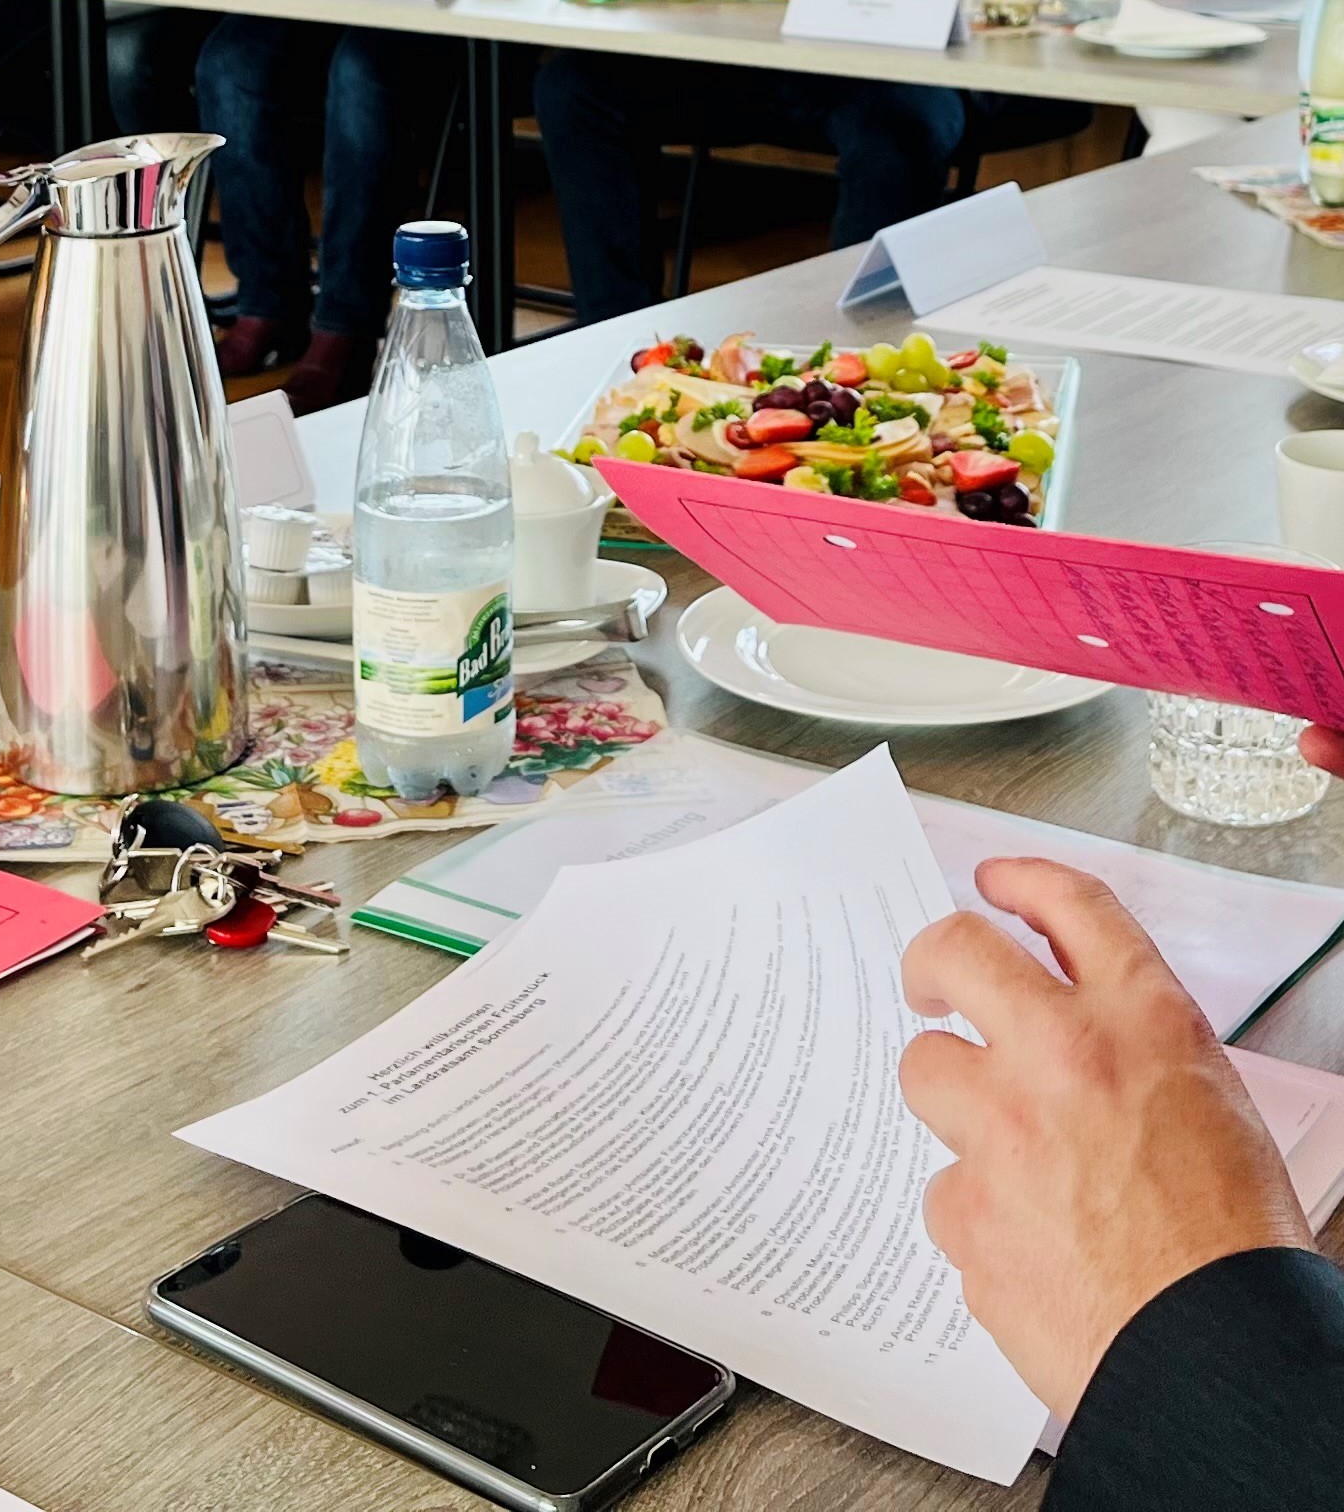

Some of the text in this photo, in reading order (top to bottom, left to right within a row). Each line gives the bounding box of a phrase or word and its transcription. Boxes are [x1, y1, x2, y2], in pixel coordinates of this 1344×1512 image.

[458, 642, 488, 688] Bad
[489, 616, 512, 660] Br
[605, 810, 707, 863] dreichung
[339, 1096, 368, 1114] zum
[379, 1019, 495, 1094] Parlamentarischen
[490, 970, 550, 1022] Frühstück
[366, 1004, 495, 1081] Herzlich willkommen
[400, 1045, 481, 1096] Landratsamt
[475, 997, 546, 1048] Sonneberg
[860, 1302, 887, 1333] durch
[904, 1288, 941, 1343] Probleme
